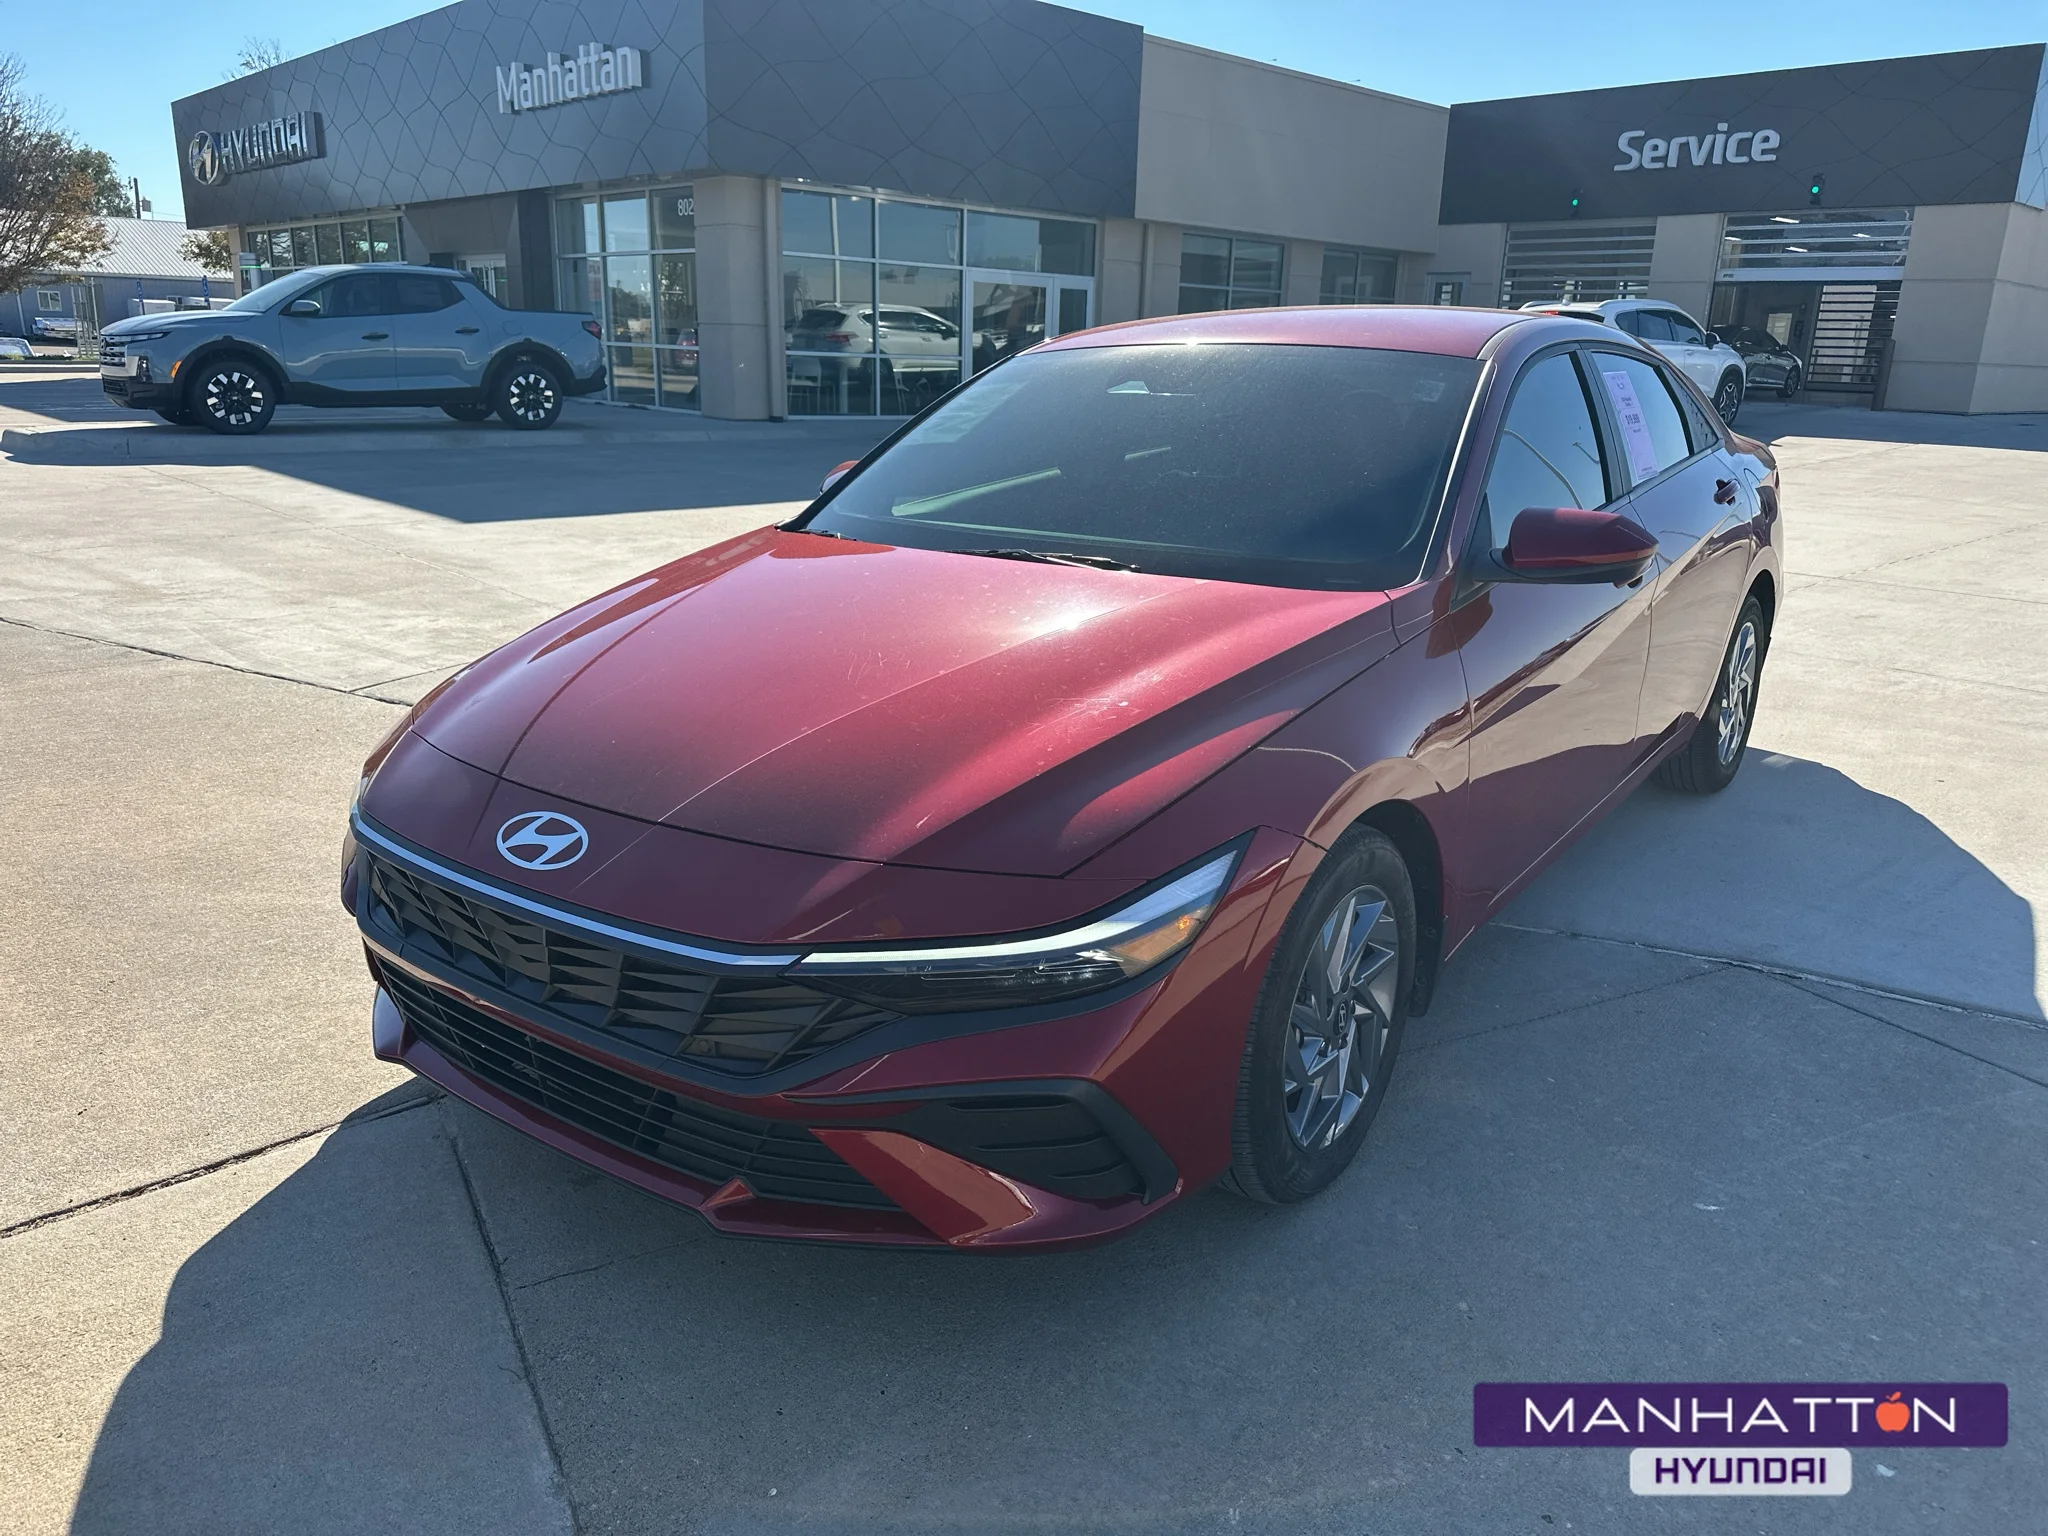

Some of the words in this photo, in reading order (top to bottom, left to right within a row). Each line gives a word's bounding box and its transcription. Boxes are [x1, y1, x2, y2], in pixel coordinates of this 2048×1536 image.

[496, 42, 638, 114] Manhattan
[220, 110, 312, 174] HYUNDAI
[1613, 122, 1780, 172] Service
[677, 197, 694, 217] 802
